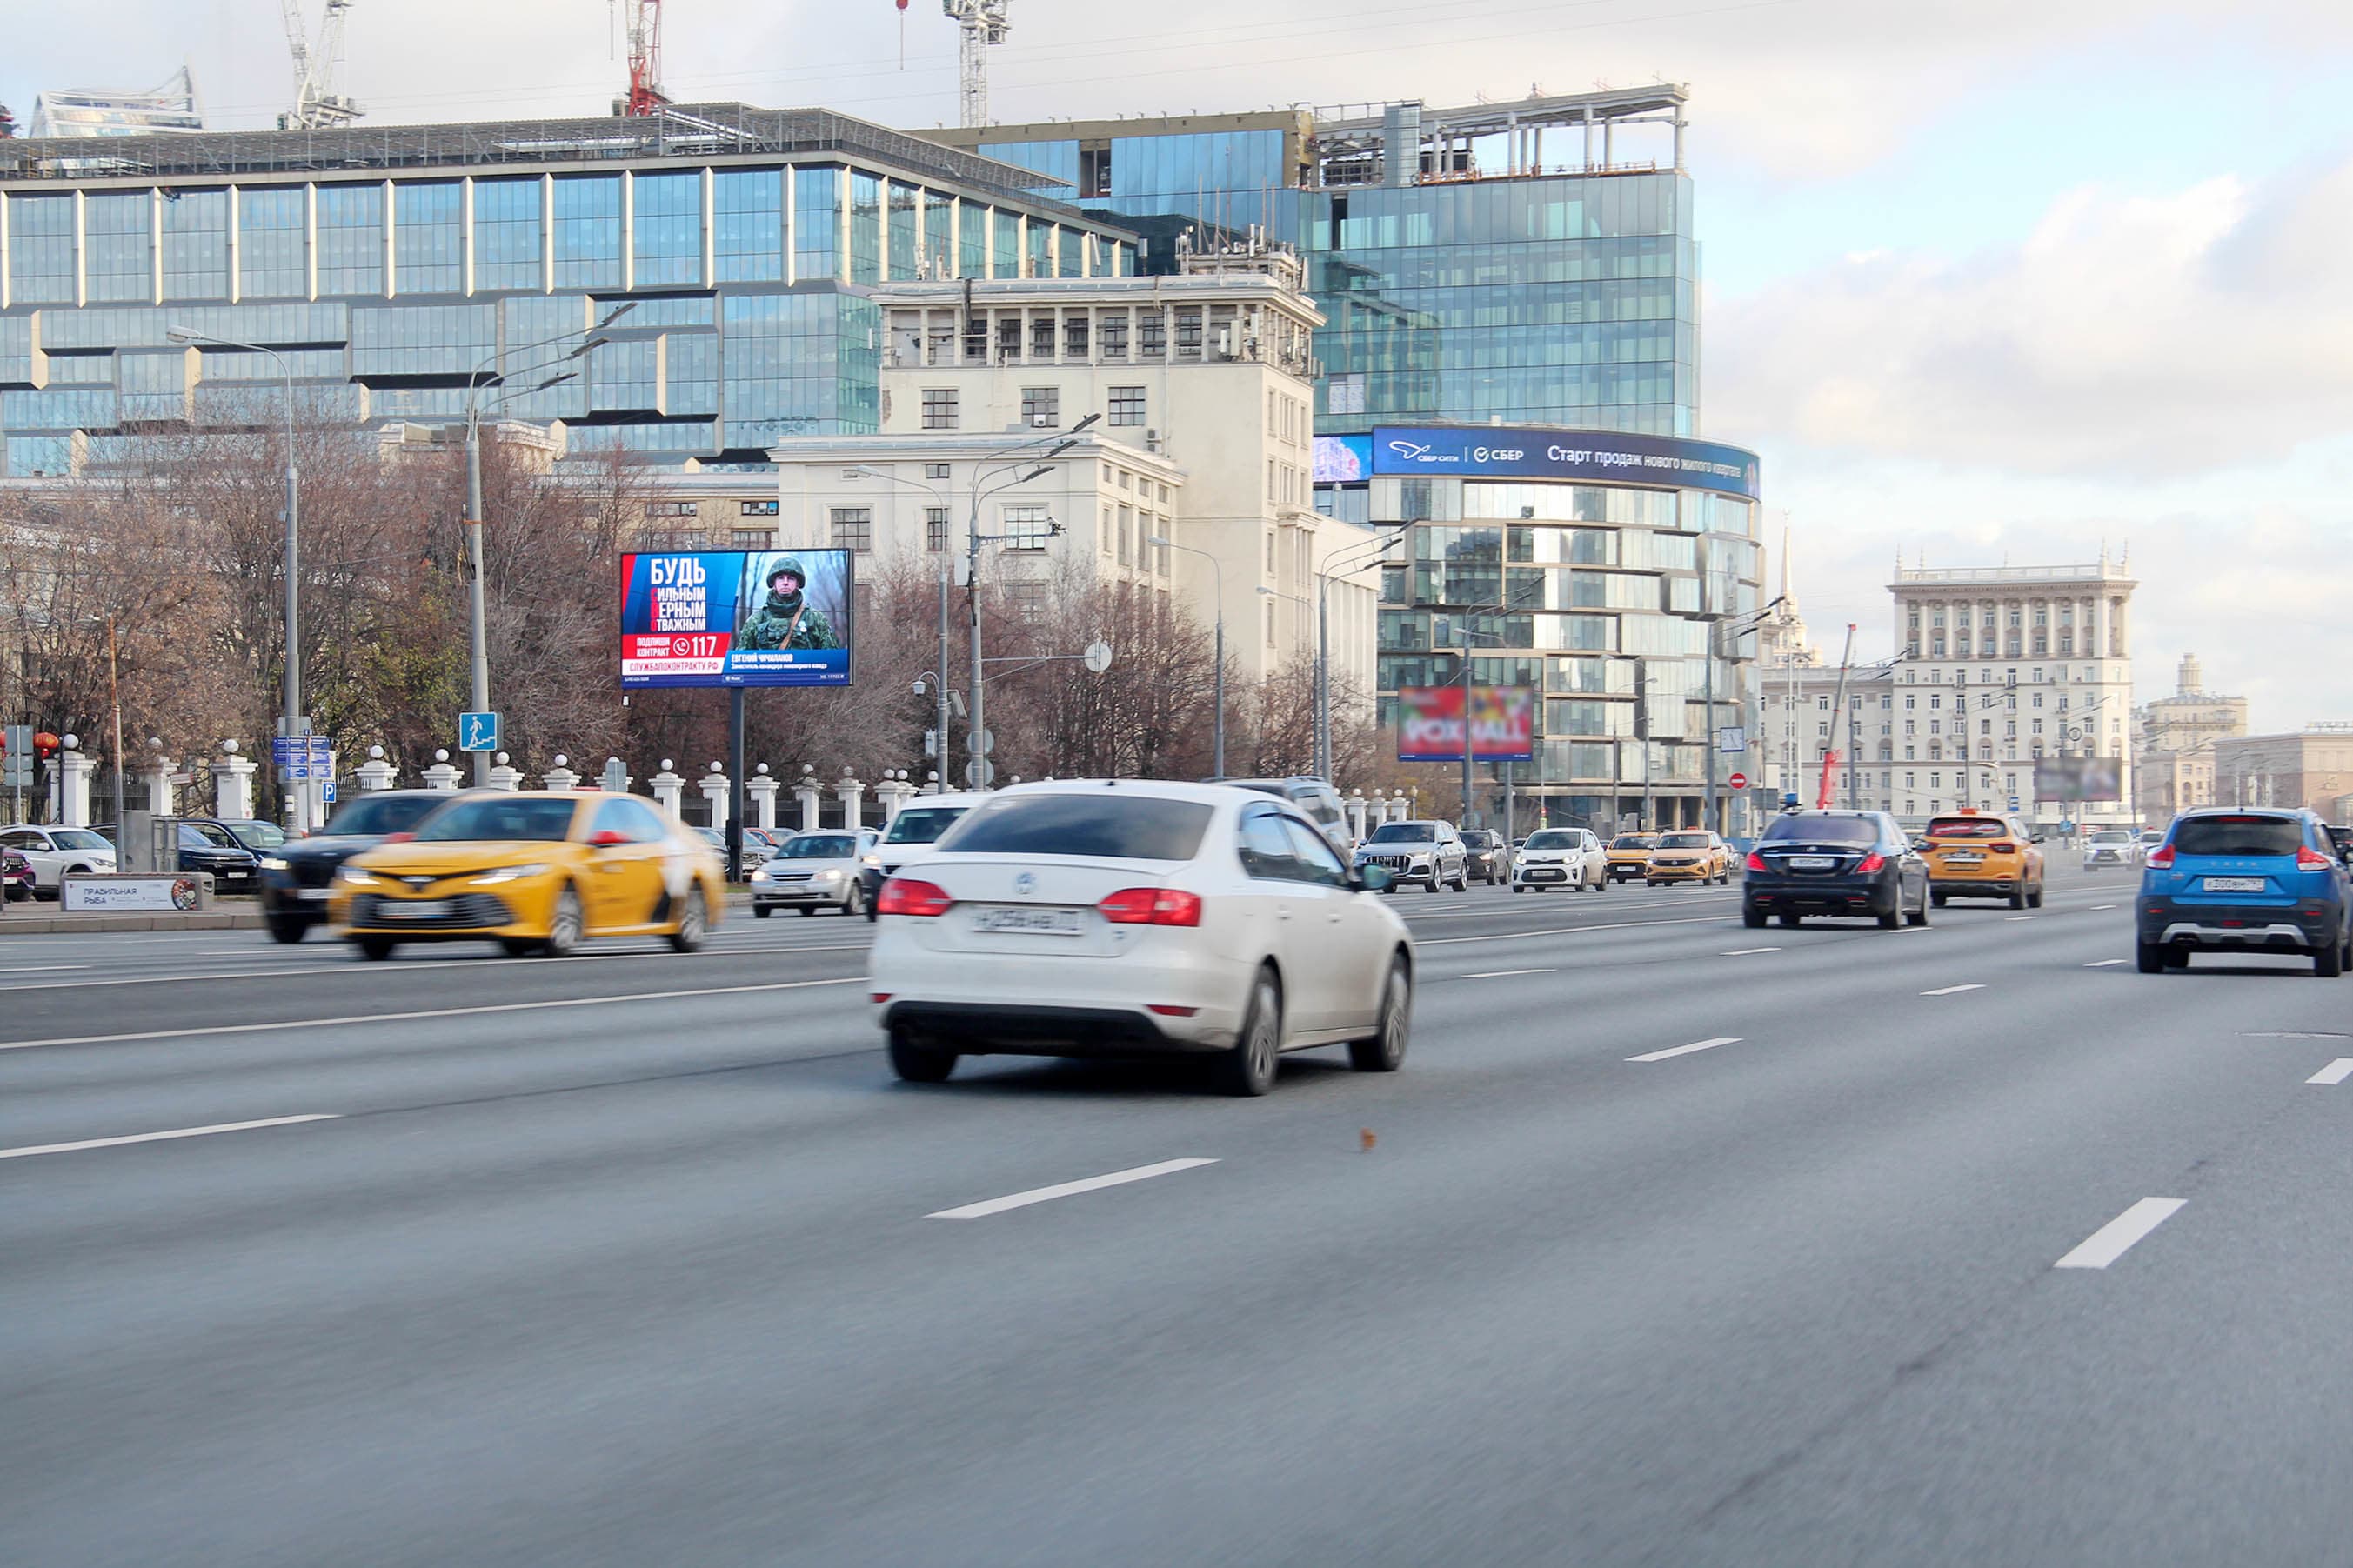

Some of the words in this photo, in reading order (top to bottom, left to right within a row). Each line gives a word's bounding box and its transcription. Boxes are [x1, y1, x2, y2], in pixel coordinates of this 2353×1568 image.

[1491, 450, 1525, 461] СБЕР
[1547, 445, 1592, 465] Старт
[1594, 451, 1642, 467] продаж
[1644, 456, 1680, 470] нового
[650, 557, 706, 588] БУДЬ
[650, 586, 706, 602] СИЛЬНЫМ
[650, 601, 706, 618] ВЕРНЫМ
[650, 617, 706, 631] ОТВАЖНЫМ
[692, 636, 717, 656] 117
[325, 784, 334, 801] P
[84, 887, 137, 896] ПРАВИЛЬНАЯ
[84, 897, 107, 905] РЫБА
